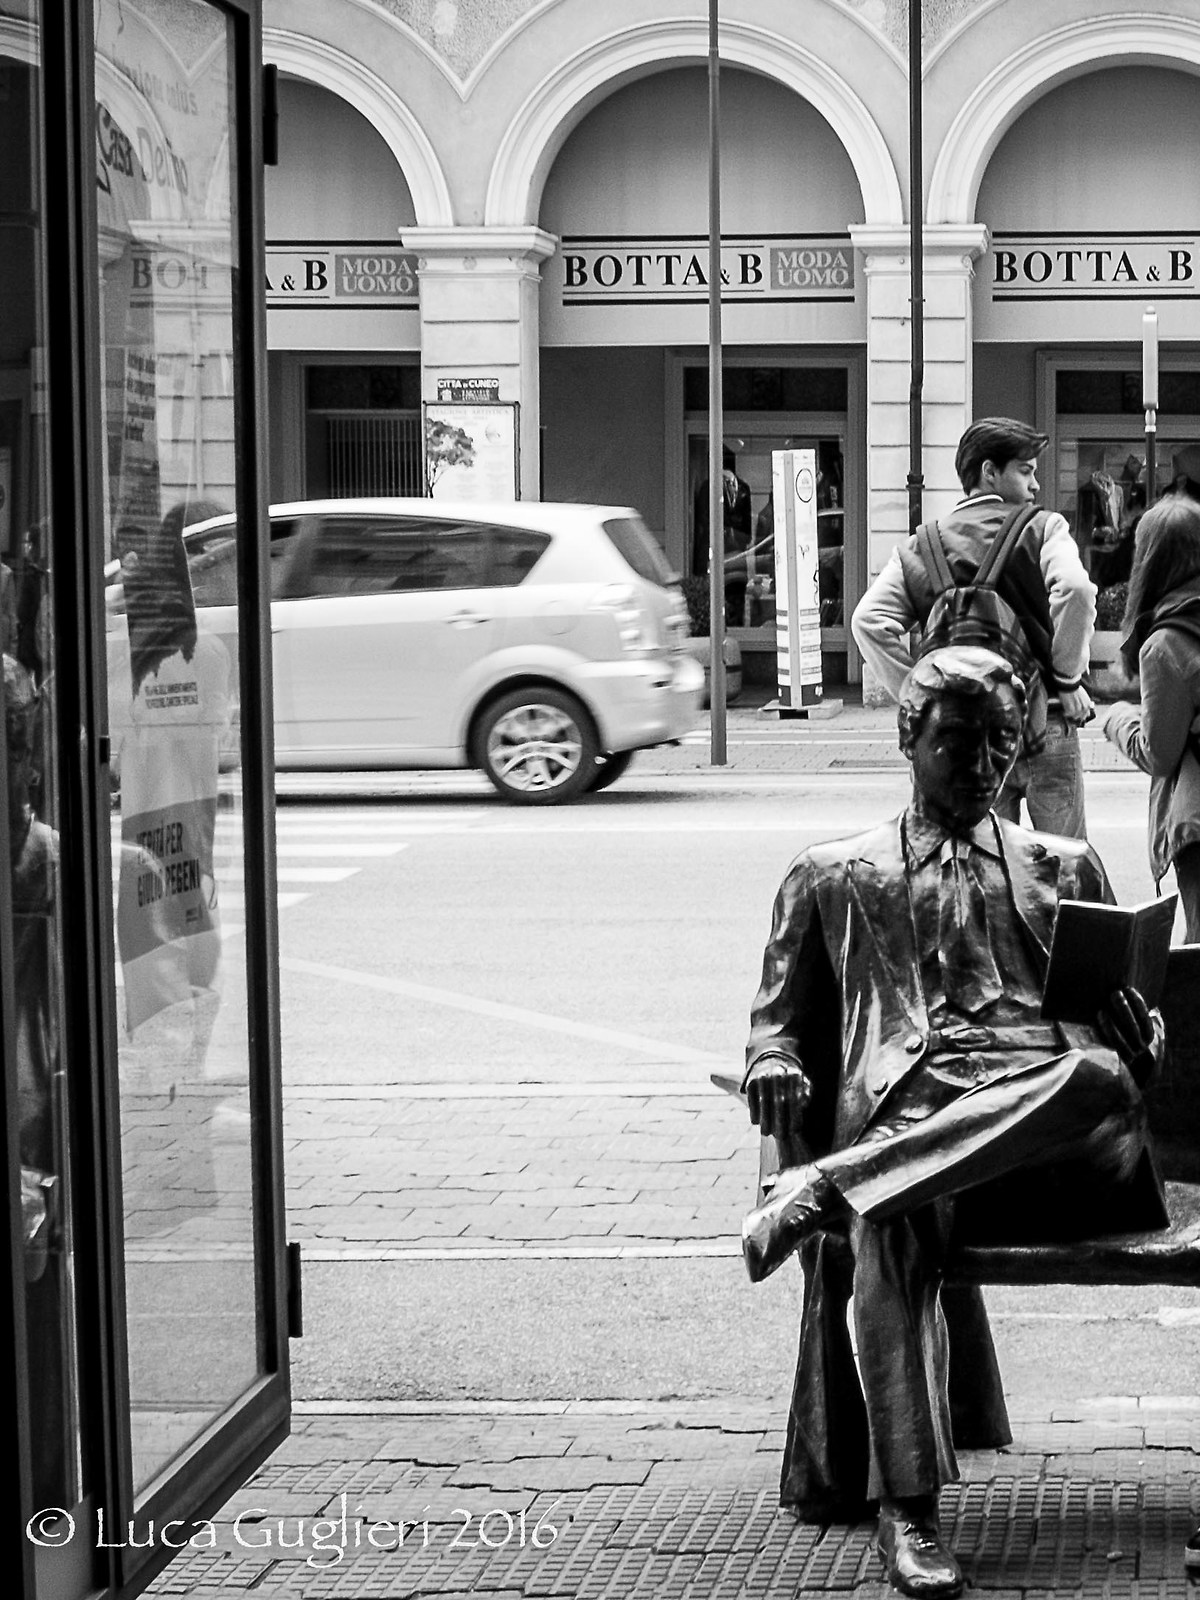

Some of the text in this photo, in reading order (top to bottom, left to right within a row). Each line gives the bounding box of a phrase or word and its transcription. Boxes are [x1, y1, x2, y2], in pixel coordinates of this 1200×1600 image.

[136, 127, 189, 196] Delno
[342, 257, 412, 275] MODA
[563, 253, 710, 286] BOTTA
[738, 252, 763, 285] B
[777, 250, 848, 268] MODA
[993, 249, 1193, 284] BOTTA & B
[281, 274, 295, 291] &
[303, 259, 328, 291] B
[342, 276, 413, 293] UOMO
[777, 268, 850, 287] UOMO
[469, 379, 499, 388] CUNEO
[165, 821, 183, 856] PER
